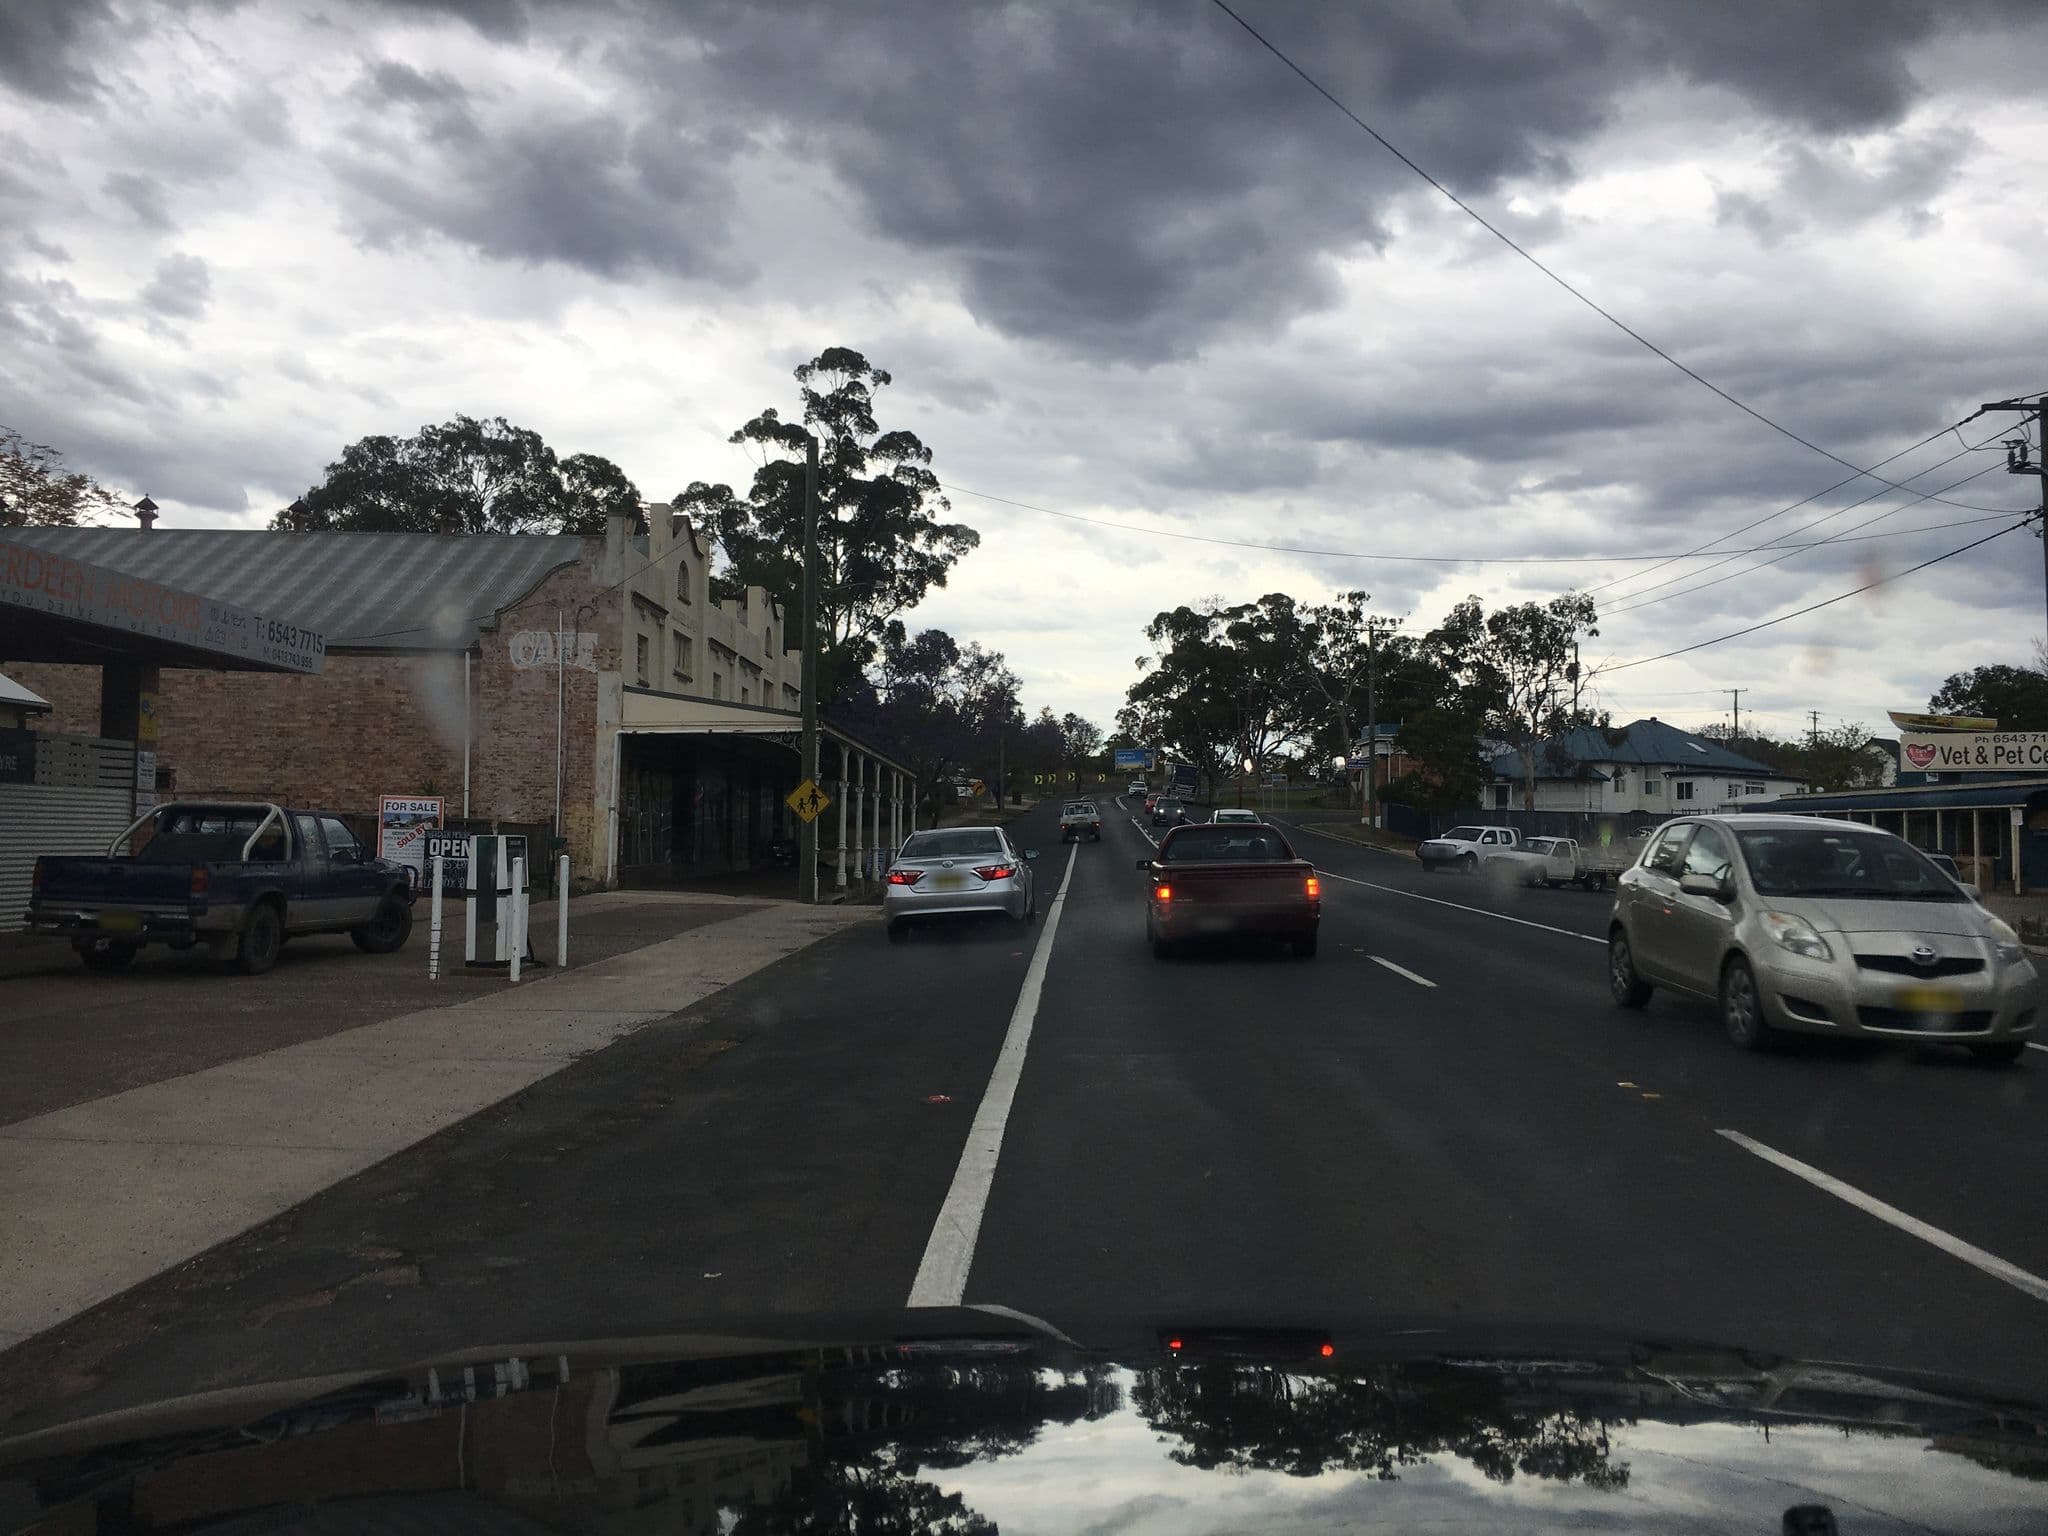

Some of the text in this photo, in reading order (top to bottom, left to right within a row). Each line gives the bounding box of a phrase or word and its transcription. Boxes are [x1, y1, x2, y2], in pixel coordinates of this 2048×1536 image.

[105, 575, 201, 630] MOTORS
[254, 616, 265, 640] T:
[268, 620, 297, 648] 6543
[299, 628, 323, 654] 7715
[1975, 736, 1989, 744] Ph
[1993, 734, 2027, 744] 6543
[1940, 745, 1970, 765] Vet
[1975, 745, 1989, 765] &
[1994, 745, 2024, 765] Pet
[385, 802, 438, 812] FOR SALE
[396, 832, 417, 849] SOLD
[416, 824, 426, 836] BY
[429, 838, 471, 857] OPEN
